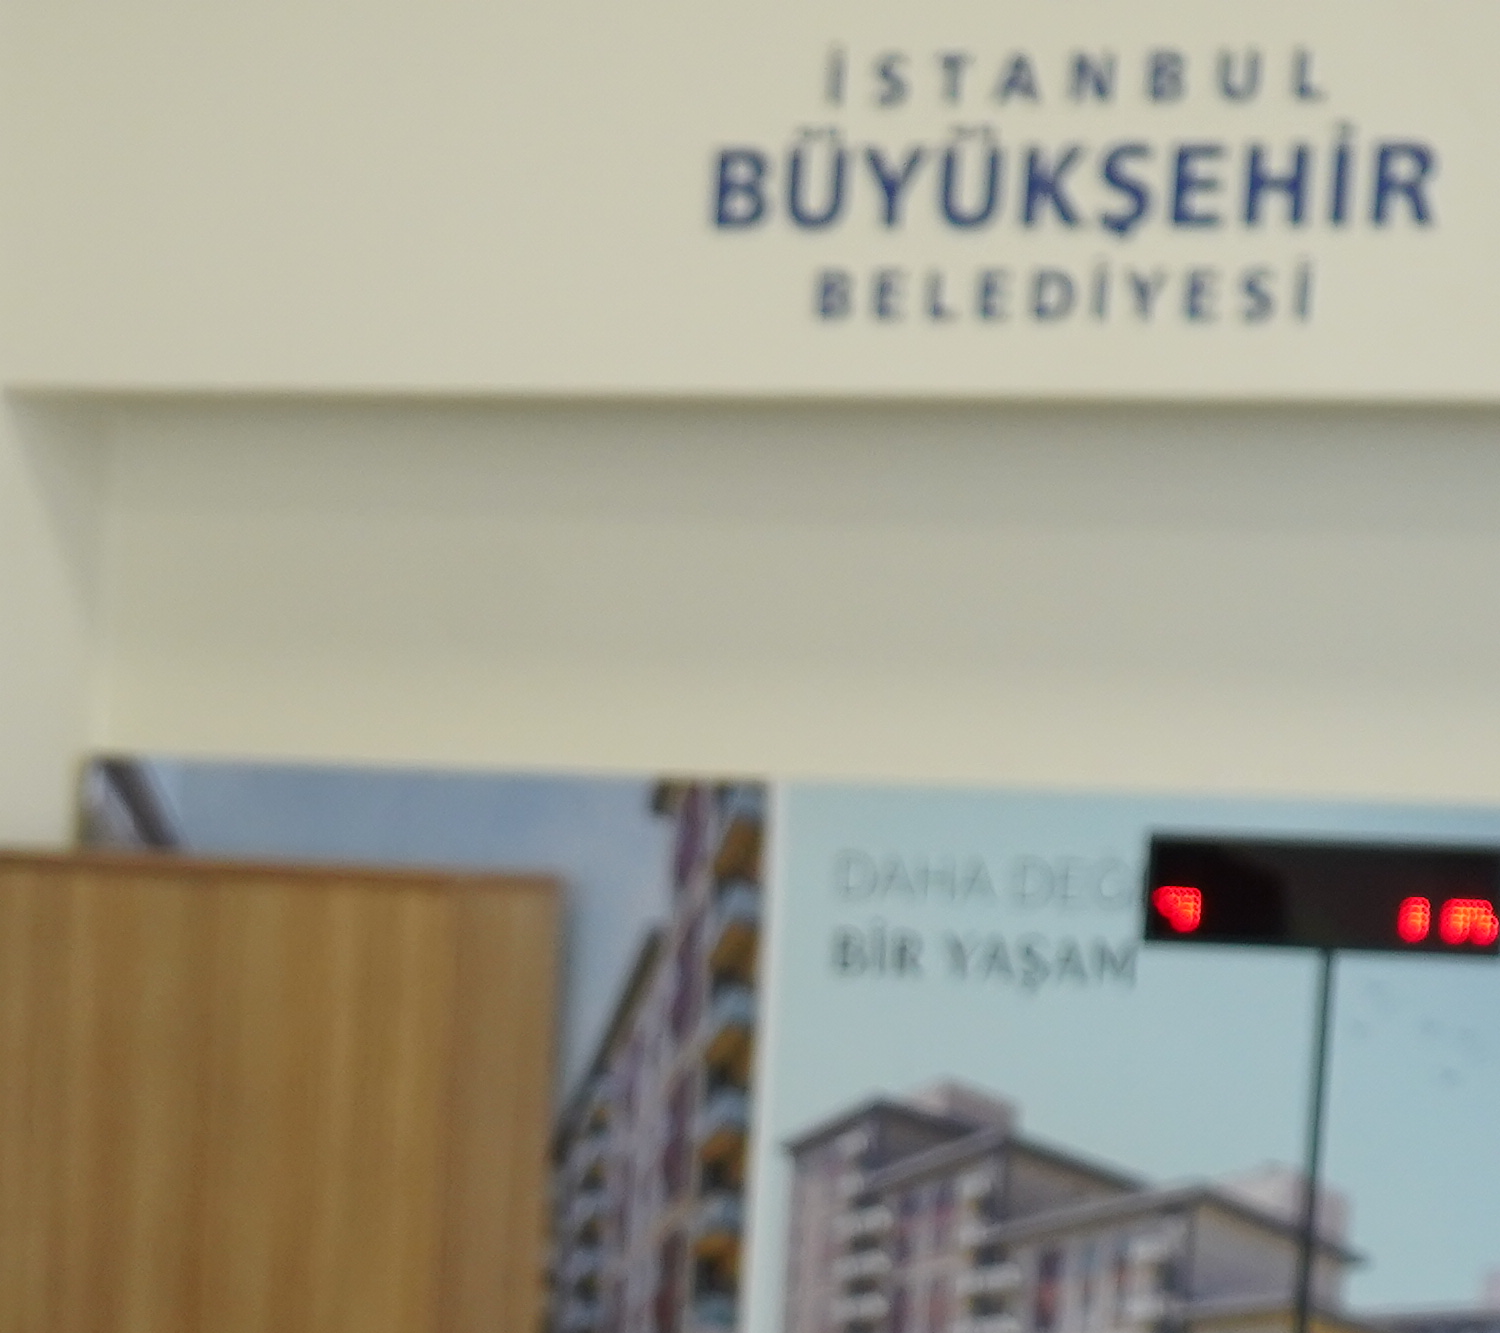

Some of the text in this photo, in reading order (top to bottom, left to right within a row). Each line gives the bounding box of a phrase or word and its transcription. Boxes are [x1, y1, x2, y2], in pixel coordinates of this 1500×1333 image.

[824, 40, 1328, 104] İSTANBUL
[710, 118, 1438, 238] BÜYÜKŞEHİR
[812, 255, 1316, 322] BELEDİYESİ
[836, 848, 1000, 904] DAHA
[831, 912, 1138, 994] BİR YAŞAM
